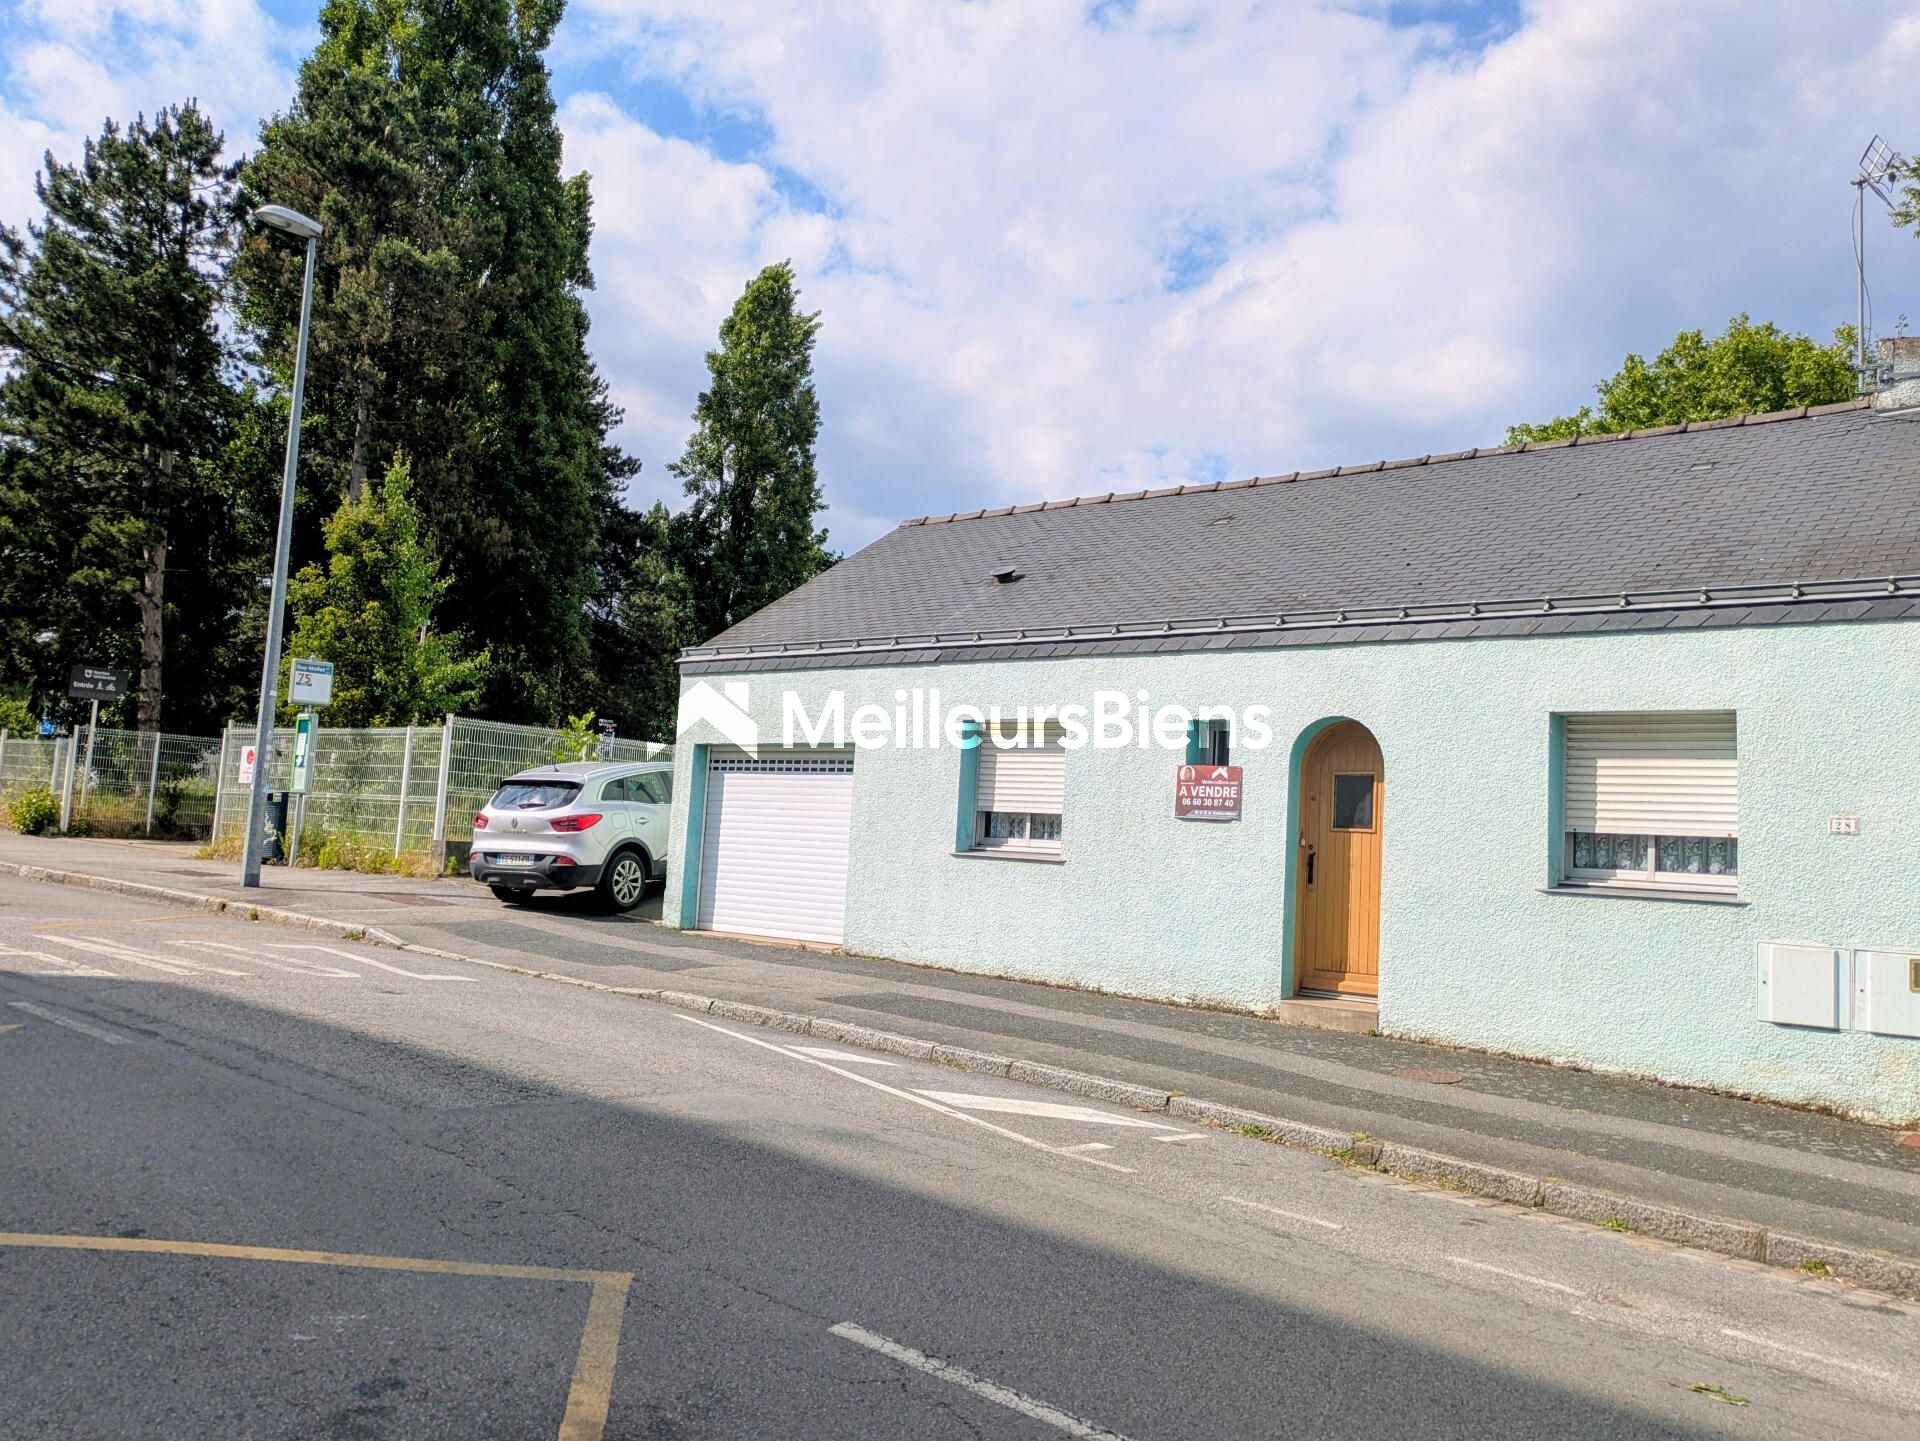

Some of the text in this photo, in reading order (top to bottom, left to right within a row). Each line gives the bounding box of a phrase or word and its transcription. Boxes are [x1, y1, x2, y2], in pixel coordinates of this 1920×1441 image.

[298, 673, 312, 683] 75
[1179, 785, 1238, 798] A VENDRE
[1182, 798, 1234, 807] 06 60 30 87 40
[1835, 821, 1851, 831] 28
